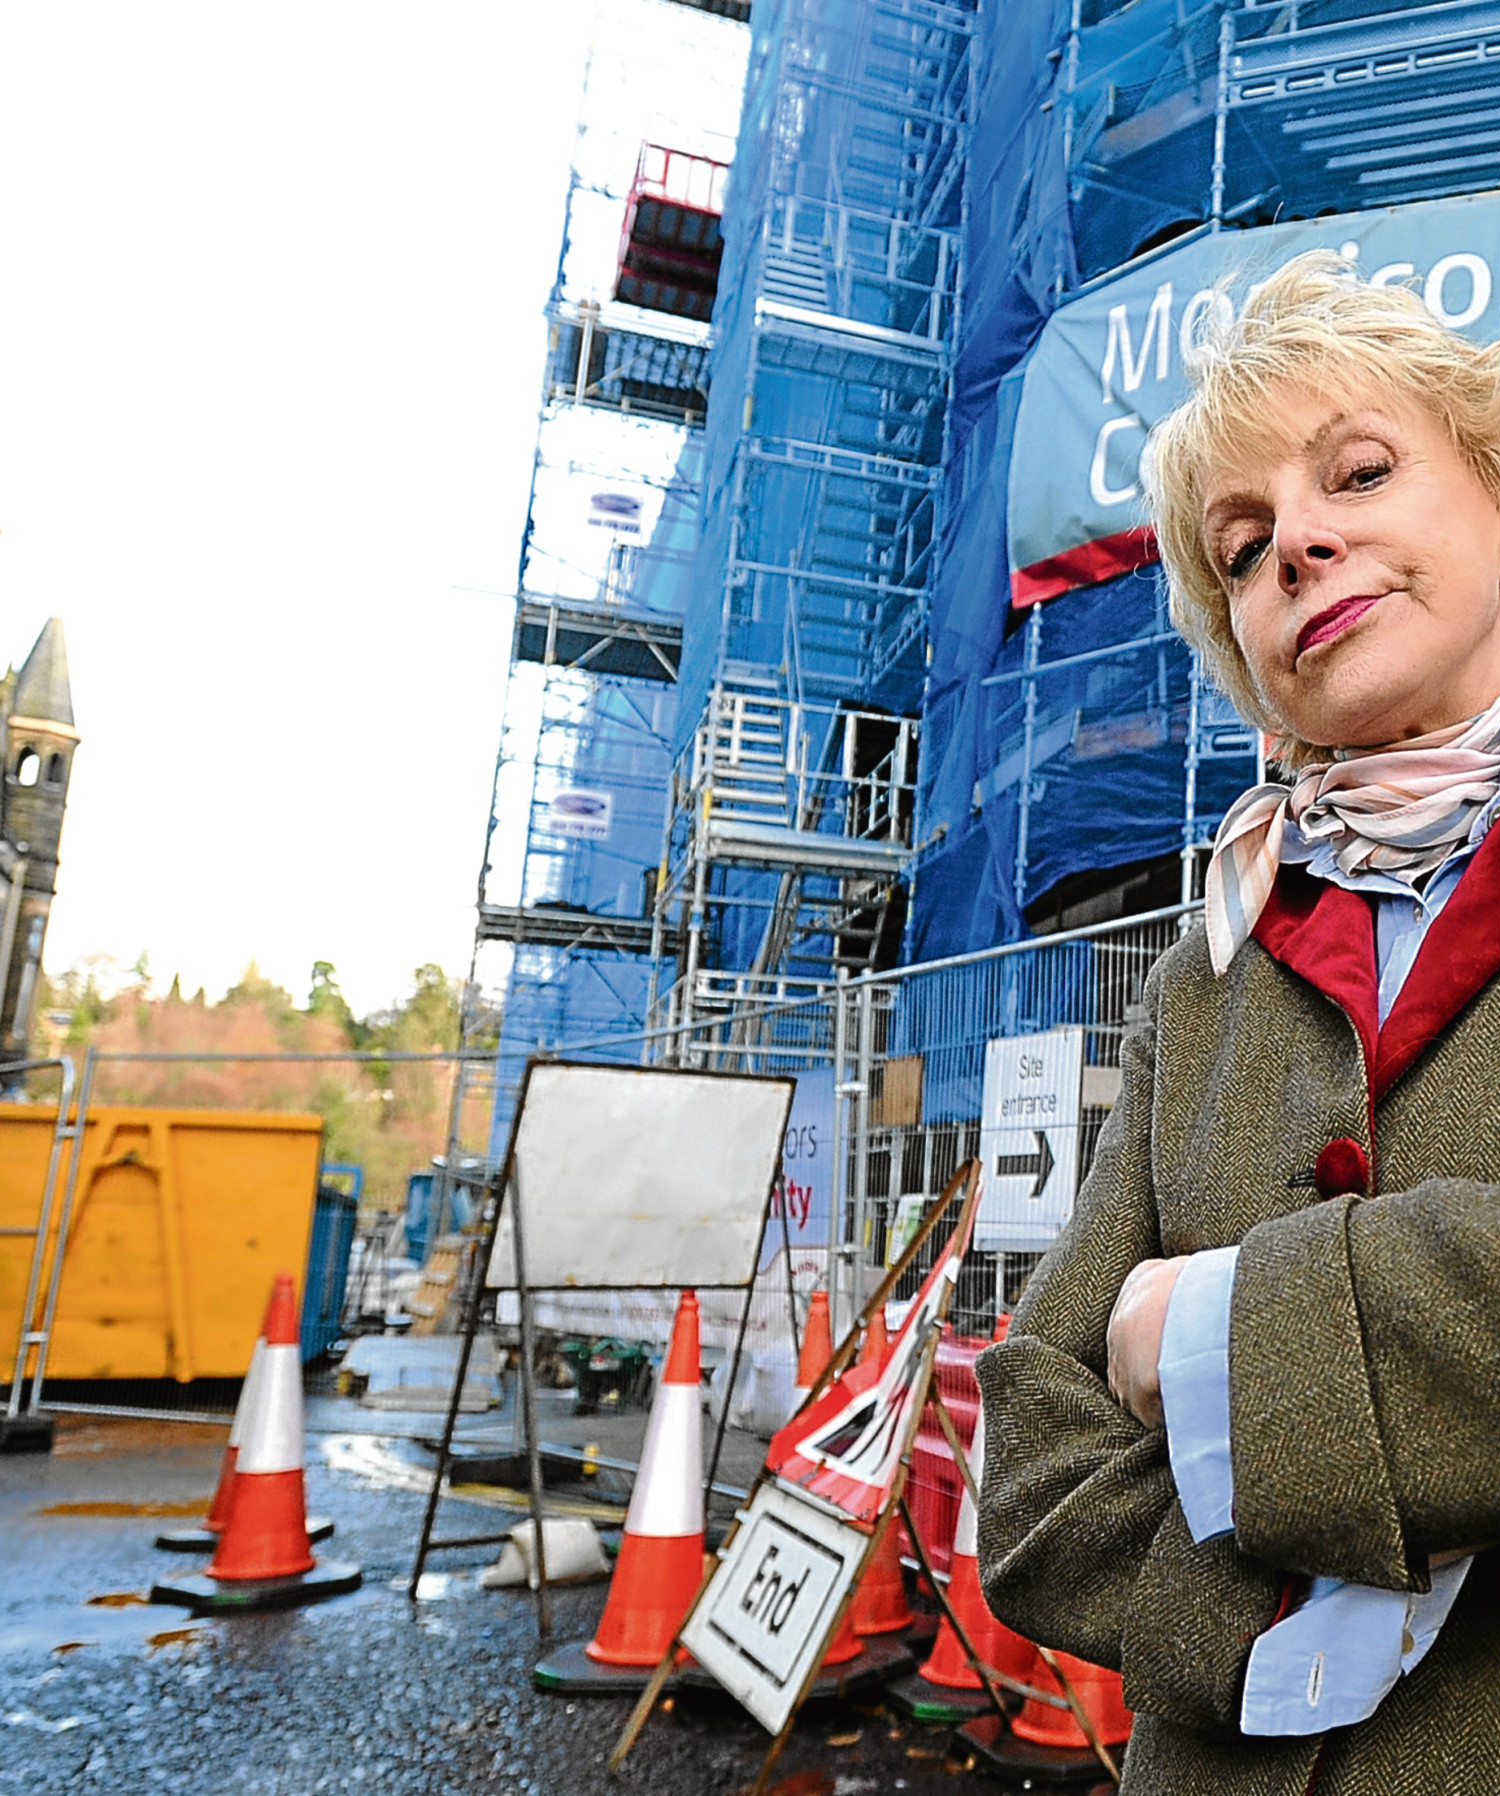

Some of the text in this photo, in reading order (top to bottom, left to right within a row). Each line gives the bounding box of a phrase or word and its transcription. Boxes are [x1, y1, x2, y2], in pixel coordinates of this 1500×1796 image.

[1018, 1055, 1044, 1080] Site
[1001, 1094, 1057, 1117] entrance
[738, 1544, 811, 1638] End
